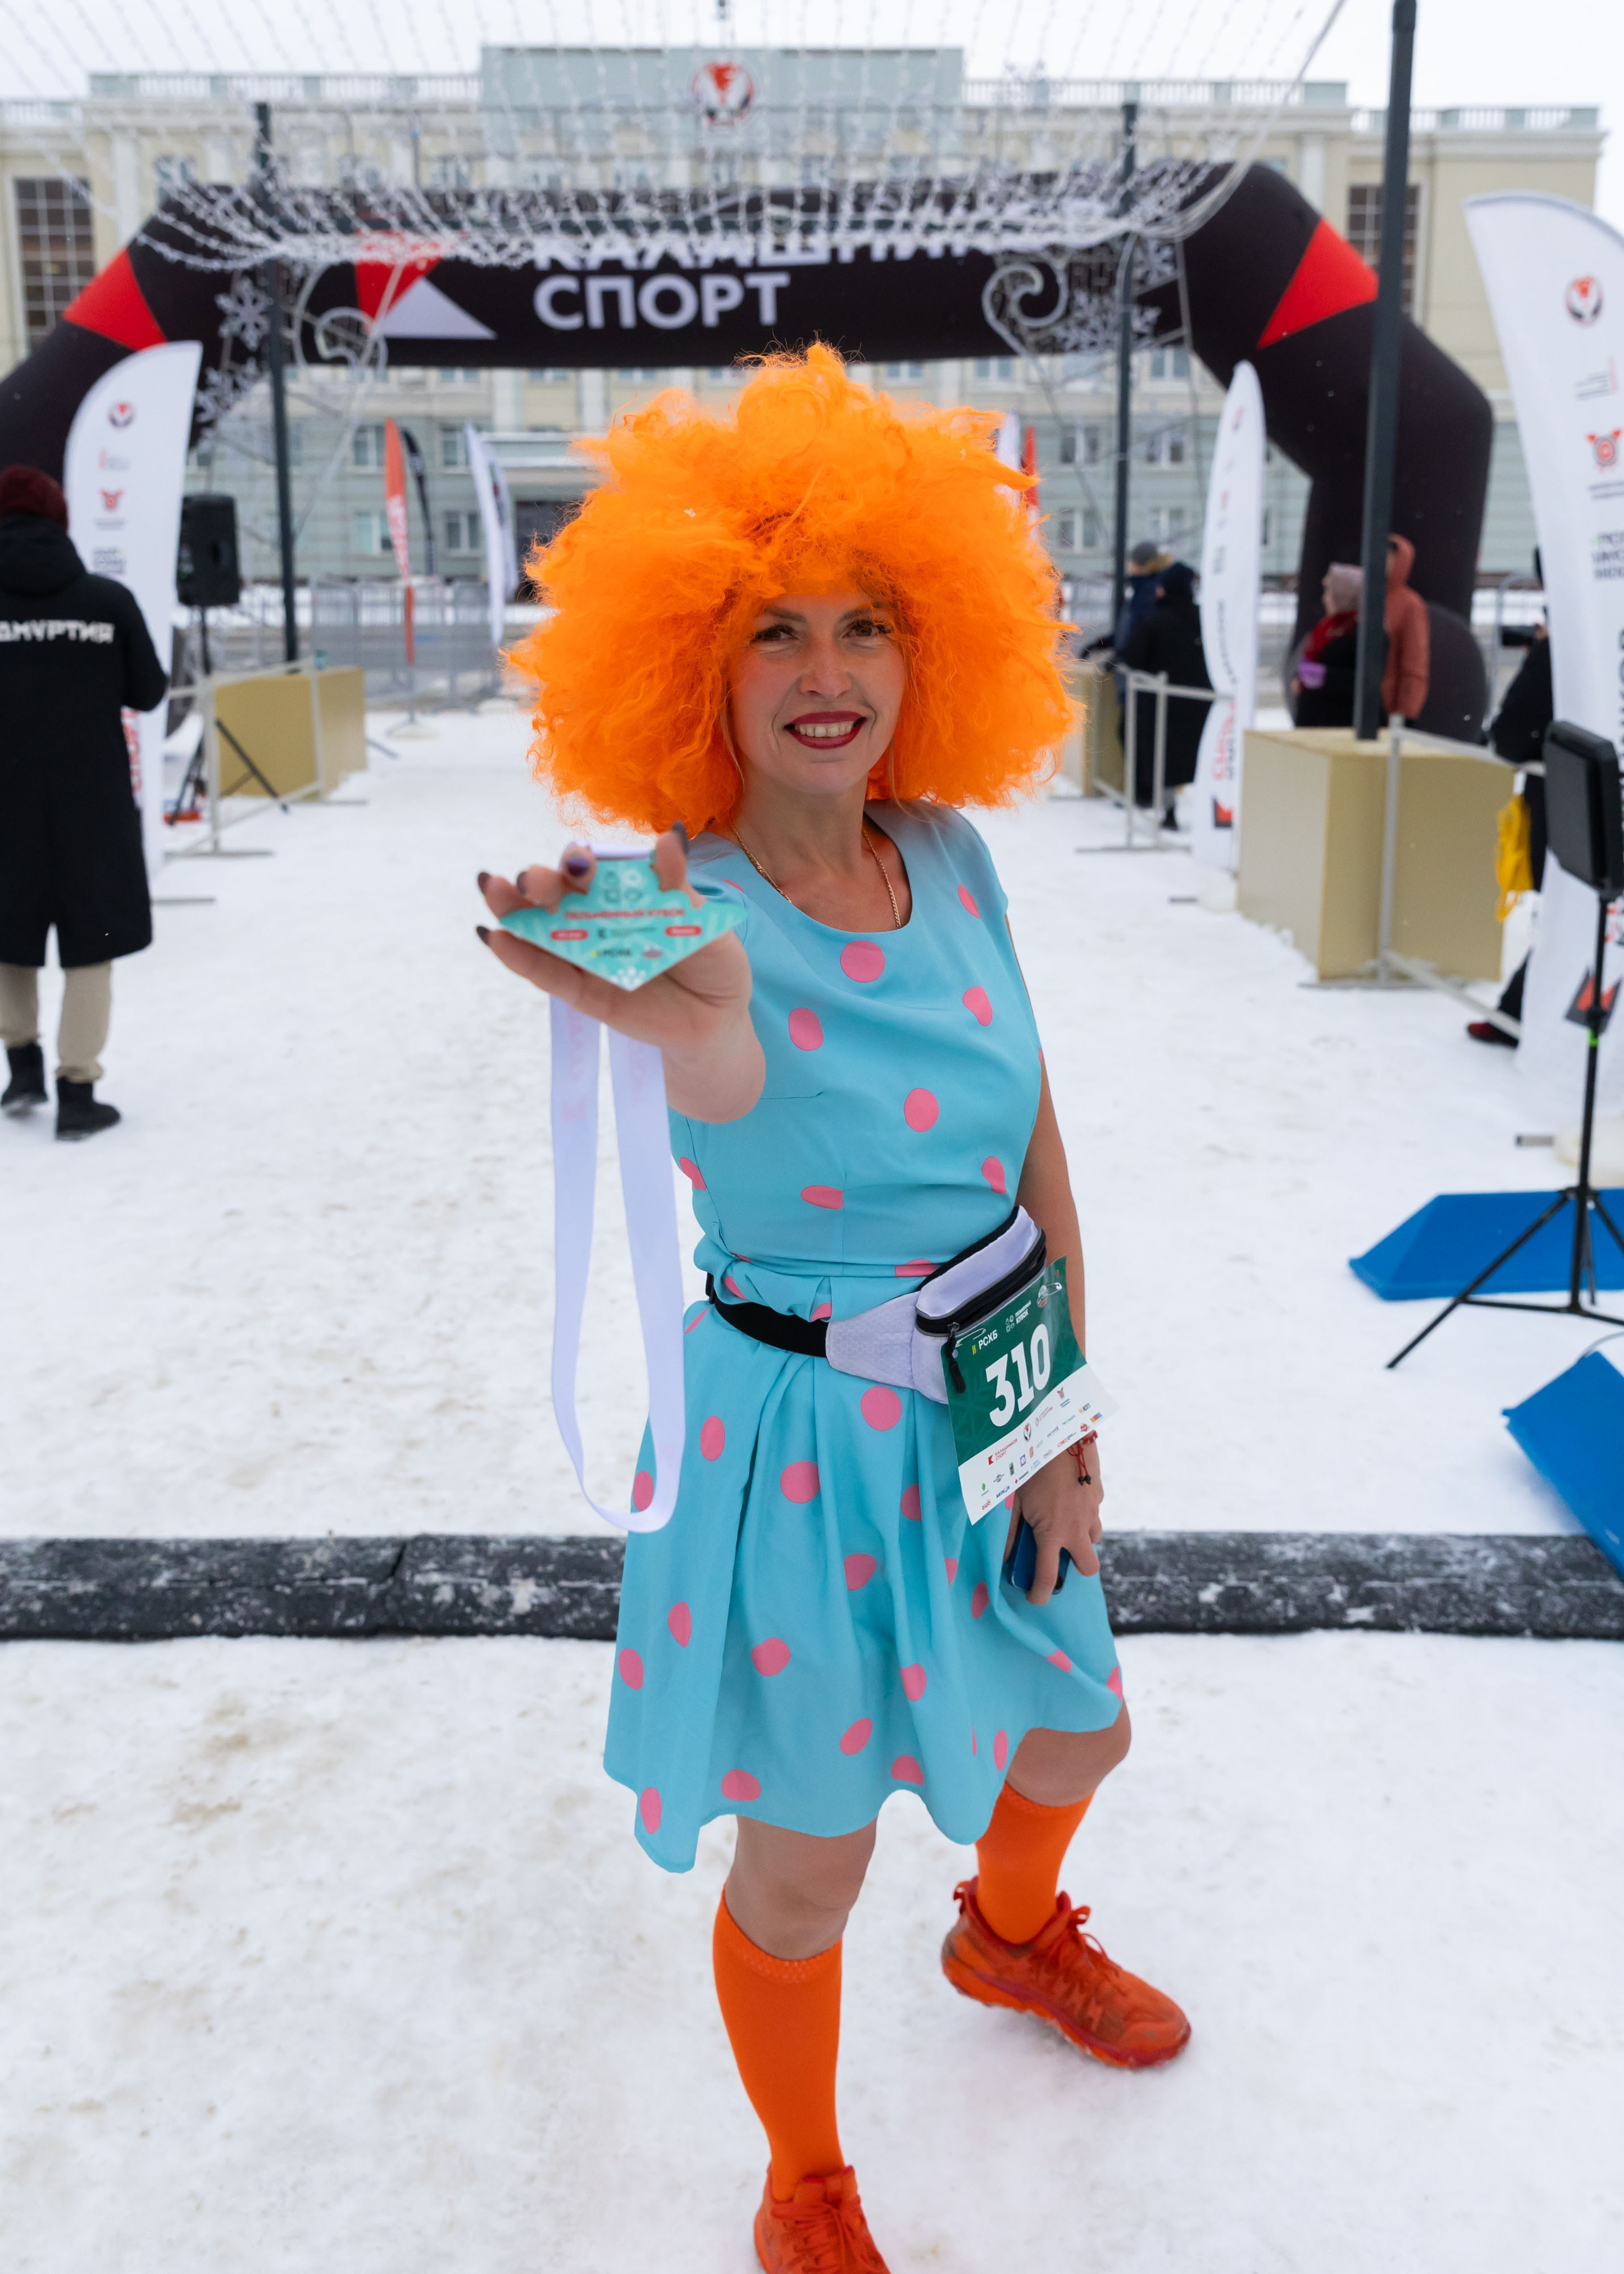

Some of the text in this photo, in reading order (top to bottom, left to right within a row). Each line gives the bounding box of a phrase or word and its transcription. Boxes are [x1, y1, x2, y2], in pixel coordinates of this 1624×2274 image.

[533, 273, 790, 331] СПОРТ
[1016, 1310, 1029, 1325] КУБОК
[978, 1330, 998, 1350] РСХБ
[985, 1324, 1051, 1427] 310
[995, 1438, 1018, 1456] КАЛАШНИКОВ
[995, 1450, 1007, 1461] СПОРТ
